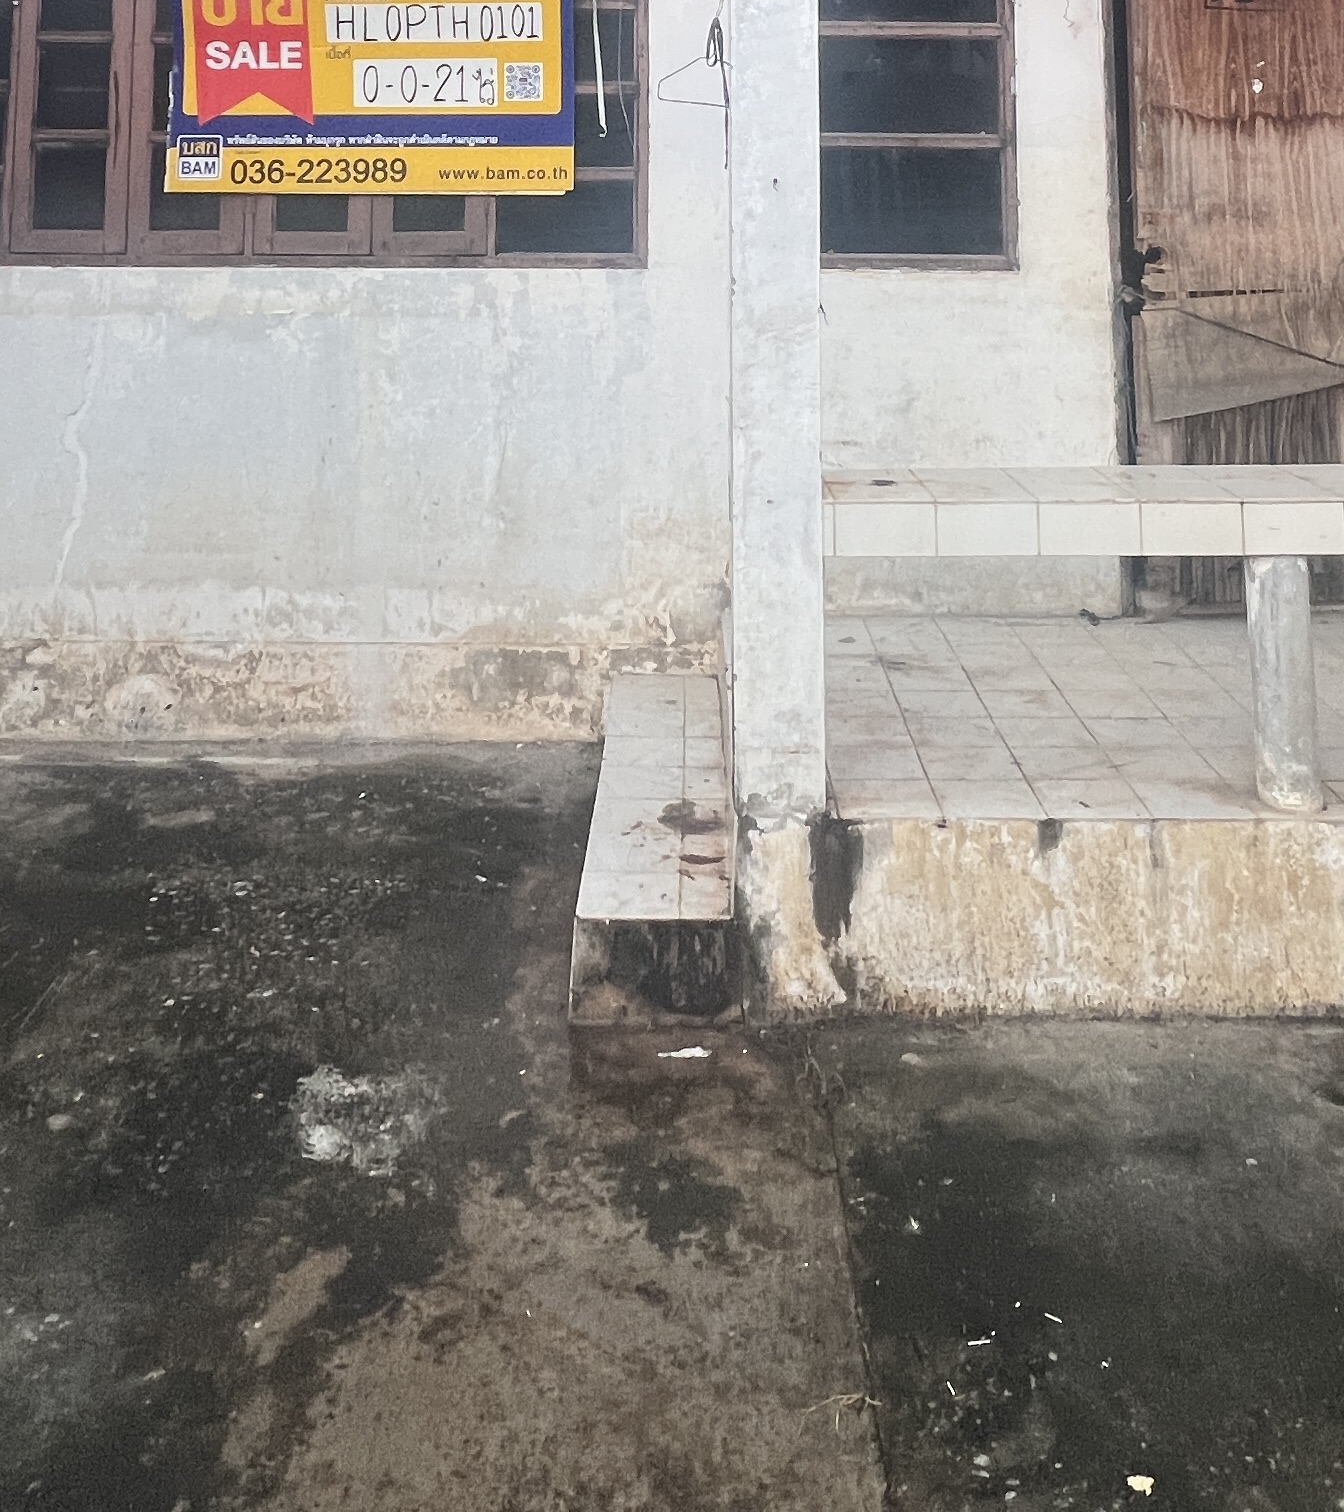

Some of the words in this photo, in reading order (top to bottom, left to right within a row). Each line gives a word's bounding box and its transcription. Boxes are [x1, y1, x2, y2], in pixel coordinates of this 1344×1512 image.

[205, 40, 303, 70] SALE
[181, 140, 218, 155] บสก
[181, 161, 217, 175] BAM
[230, 158, 407, 184] 036-223989
[438, 166, 568, 180] www.bam.co.th
